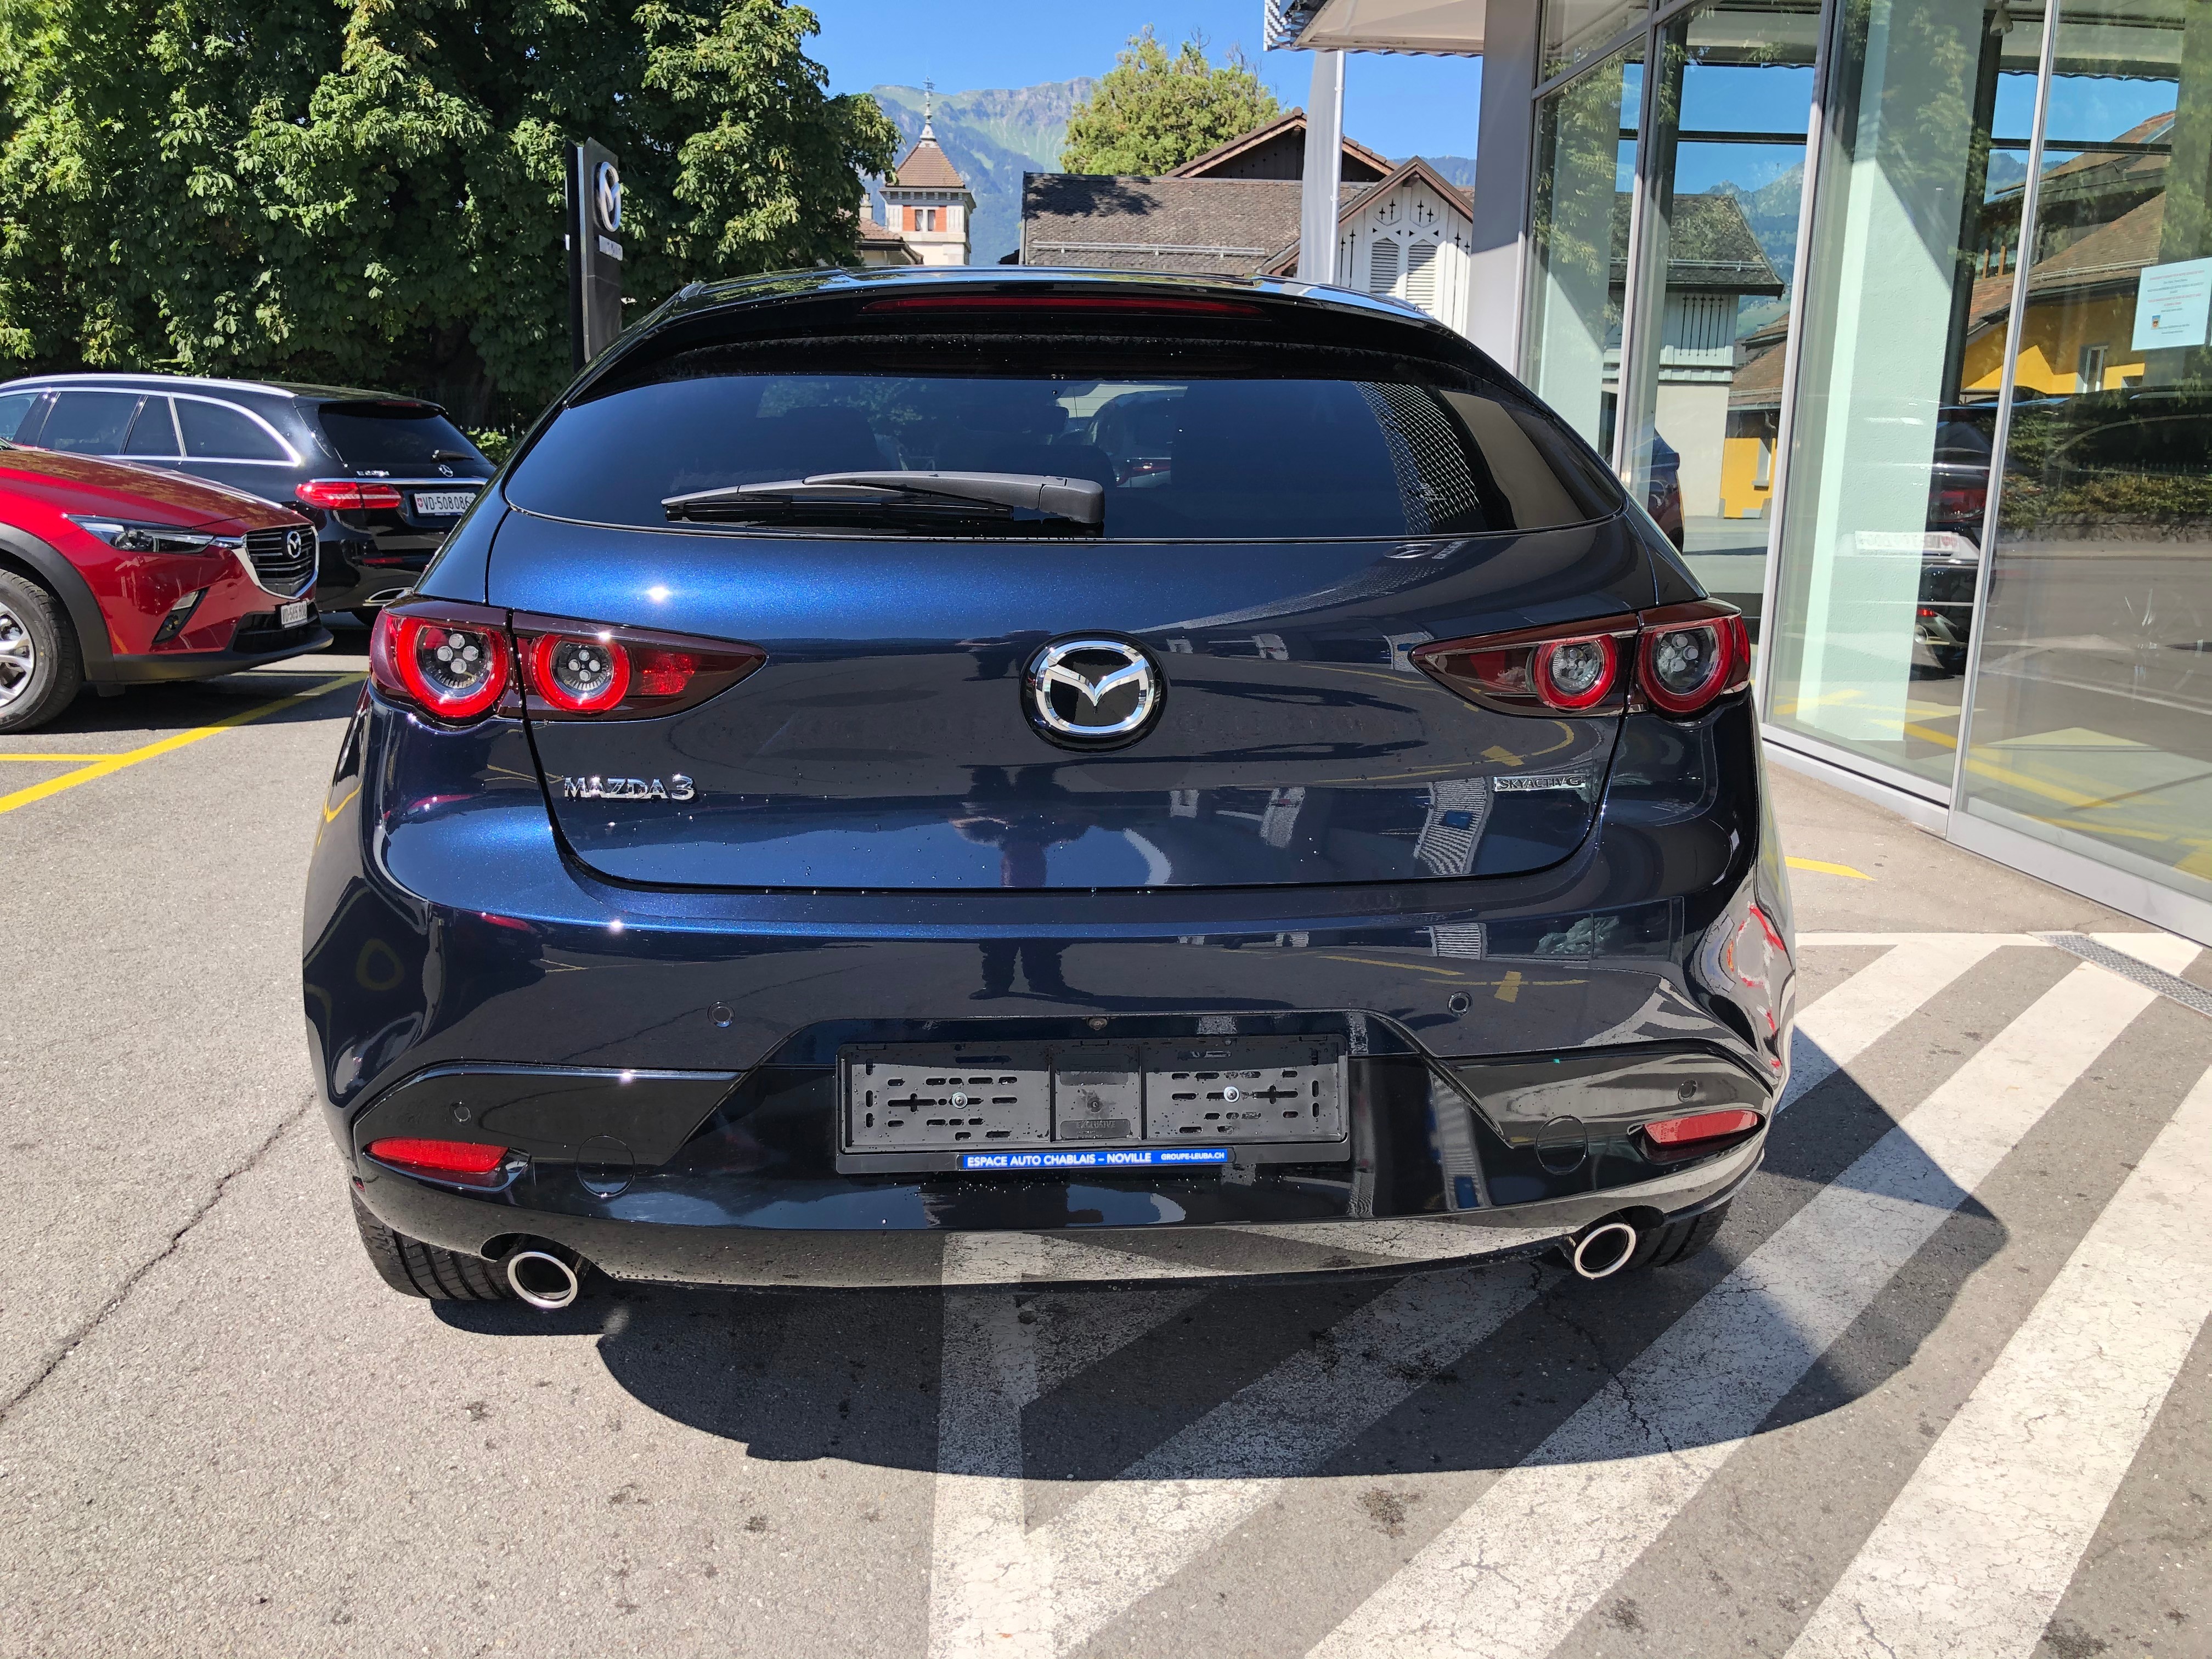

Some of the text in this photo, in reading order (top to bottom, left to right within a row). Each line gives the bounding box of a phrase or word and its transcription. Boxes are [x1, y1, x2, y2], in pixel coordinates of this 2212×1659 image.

[967, 1156, 1008, 1167] ESPACE
[1010, 1155, 1042, 1166] AUTO
[1043, 1153, 1096, 1165] CHABLAIS
[1107, 1152, 1152, 1164] NOVILLE
[1161, 1152, 1225, 1161] GROUPE-LEUBA.CH
